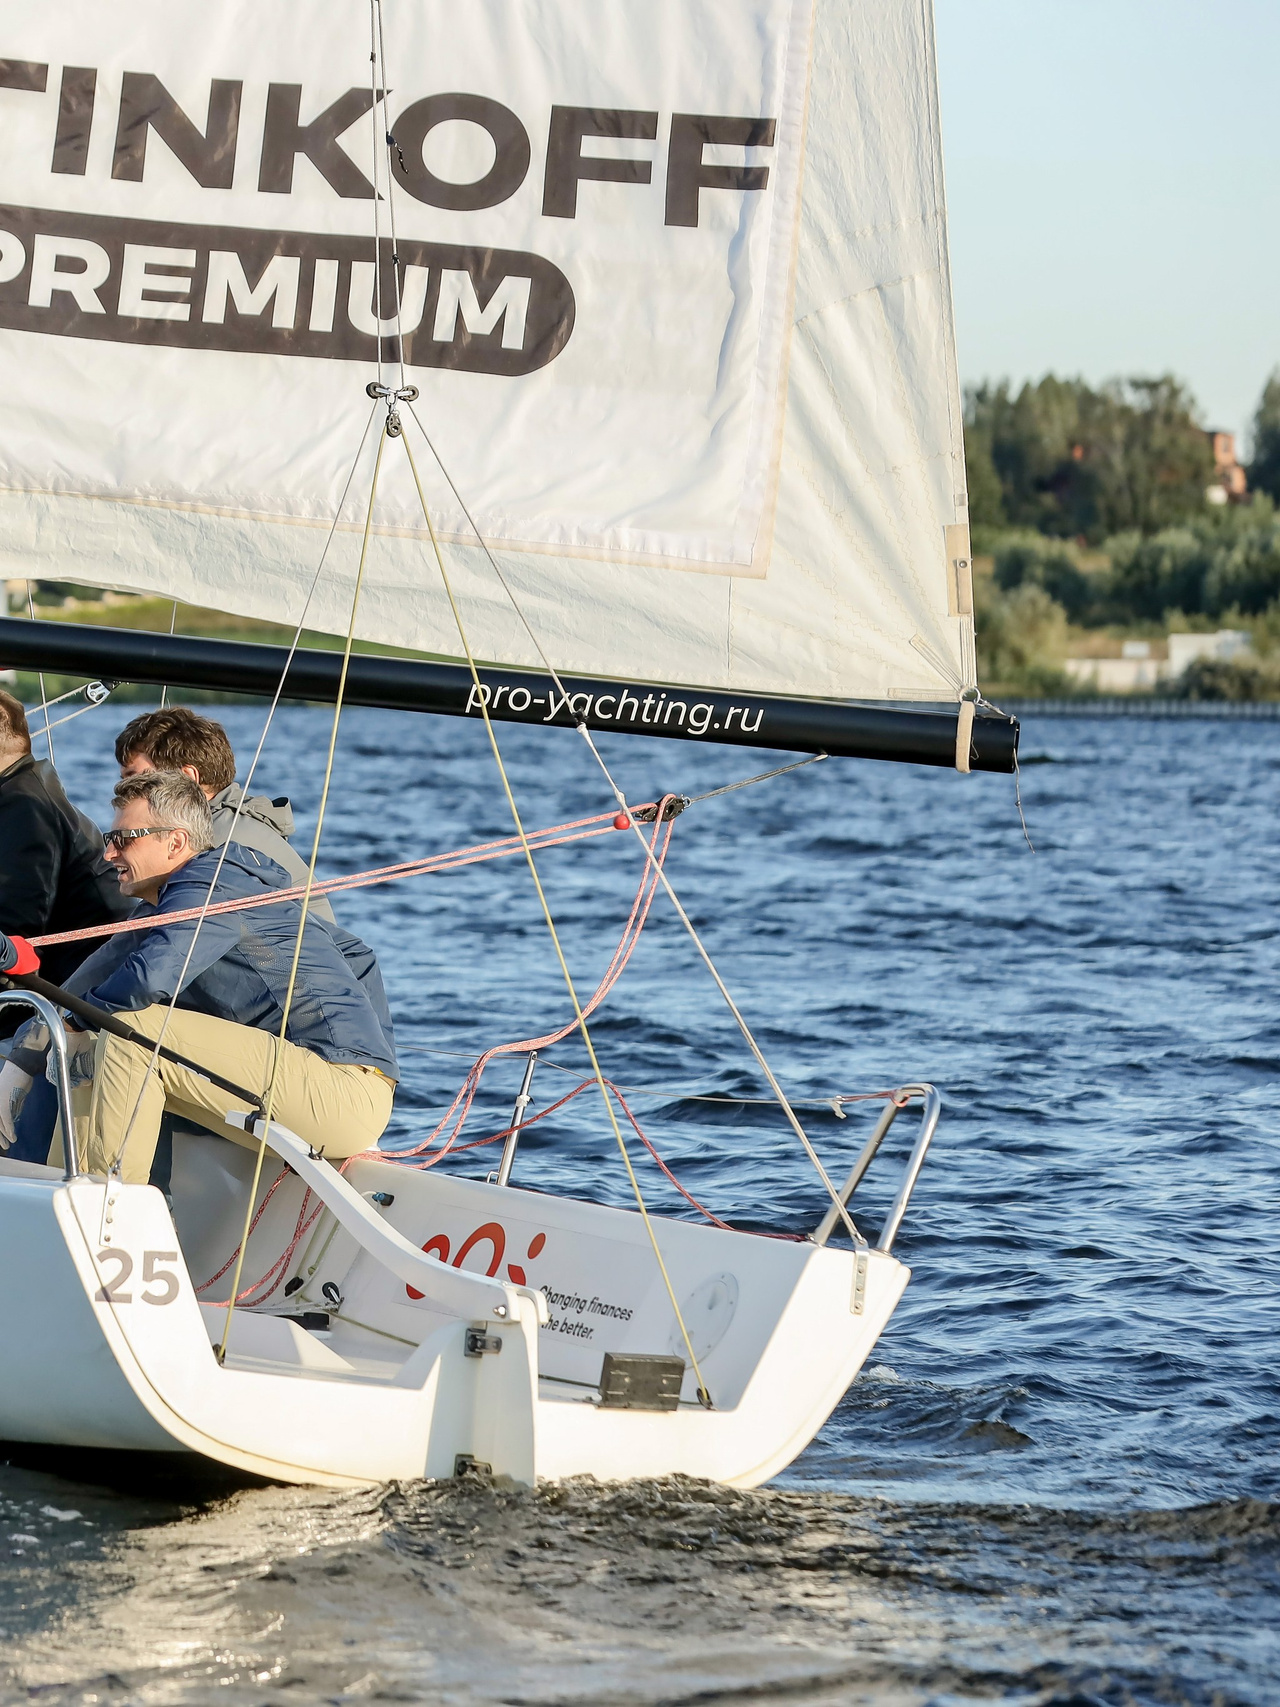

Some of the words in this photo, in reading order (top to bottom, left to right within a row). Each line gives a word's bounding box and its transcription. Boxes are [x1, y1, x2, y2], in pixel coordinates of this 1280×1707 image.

[465, 682, 764, 735] pro-yachting.ru
[94, 1247, 181, 1307] 25
[541, 1313, 560, 1332] he
[559, 1316, 596, 1341] better.
[586, 1296, 634, 1321] finances
